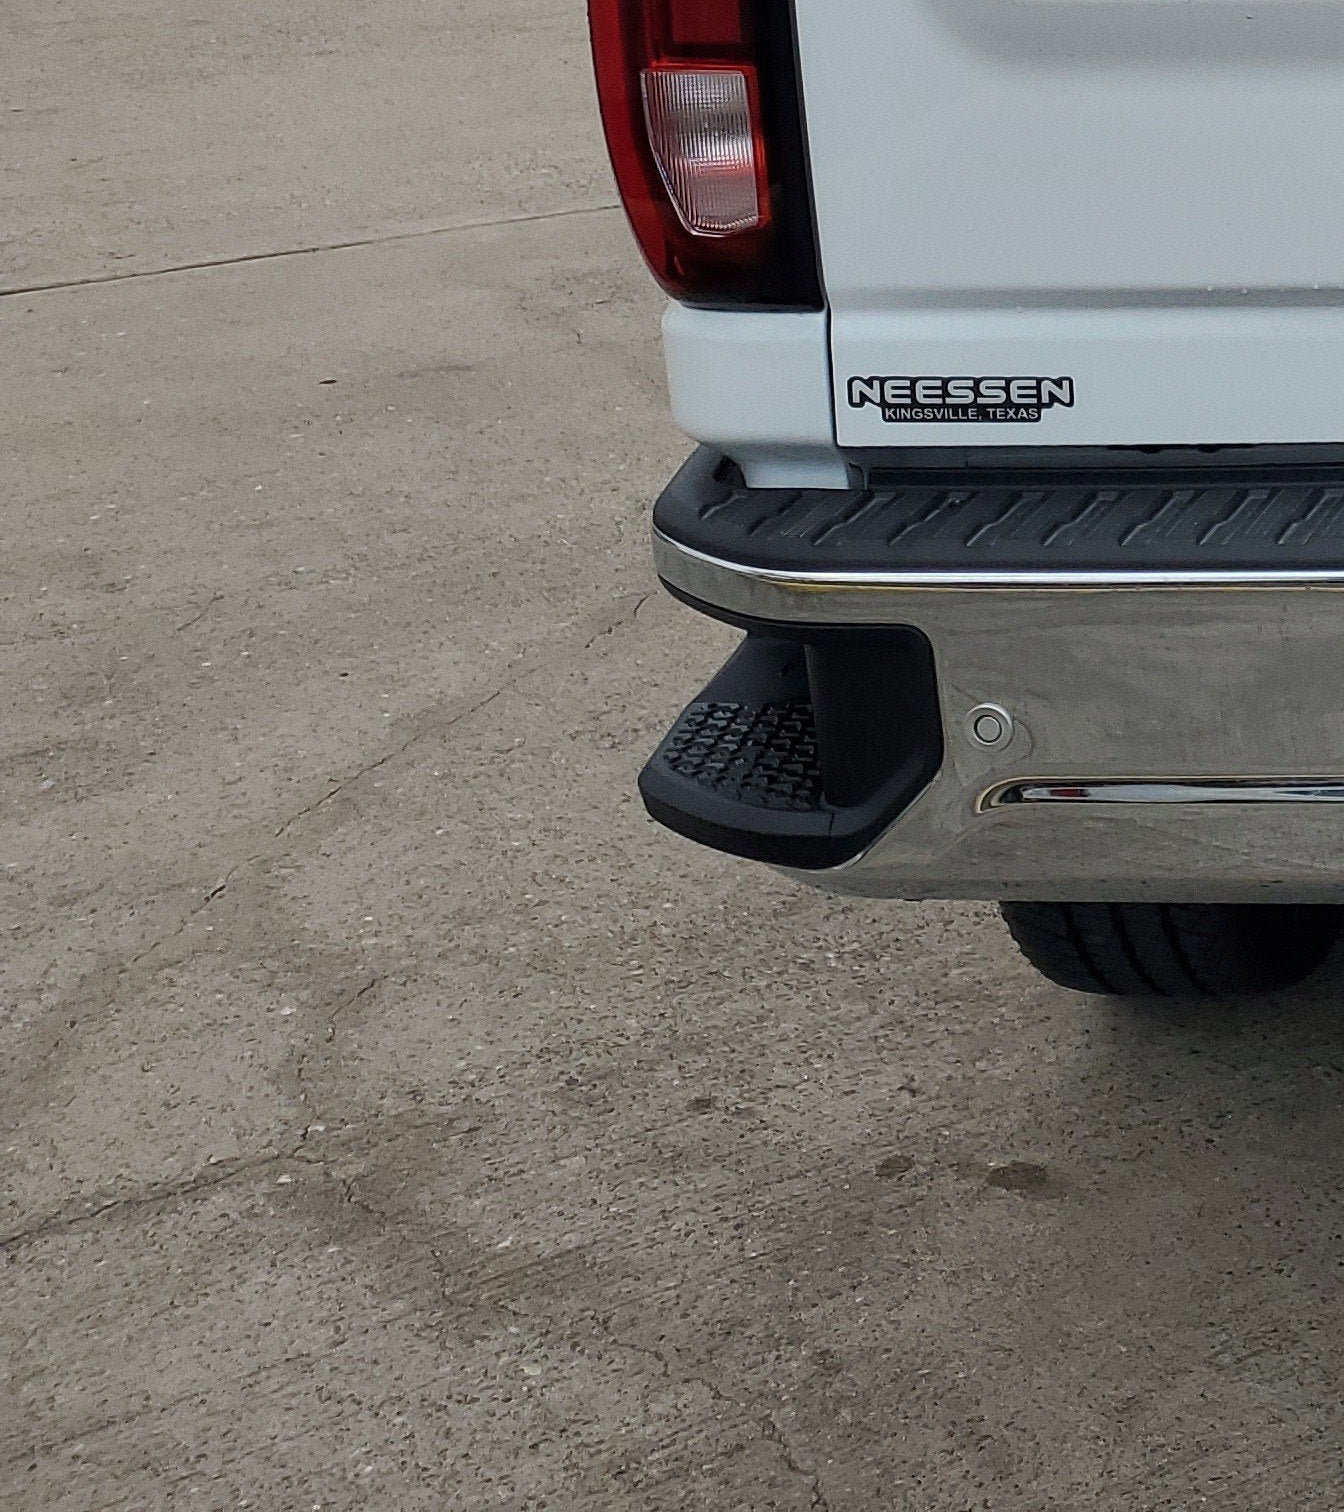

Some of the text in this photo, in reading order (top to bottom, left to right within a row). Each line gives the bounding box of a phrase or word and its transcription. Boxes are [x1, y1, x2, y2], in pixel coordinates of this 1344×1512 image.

[850, 378, 1072, 405] NEESSEN
[884, 407, 1039, 421] KINGSVILLE, TEXAS
